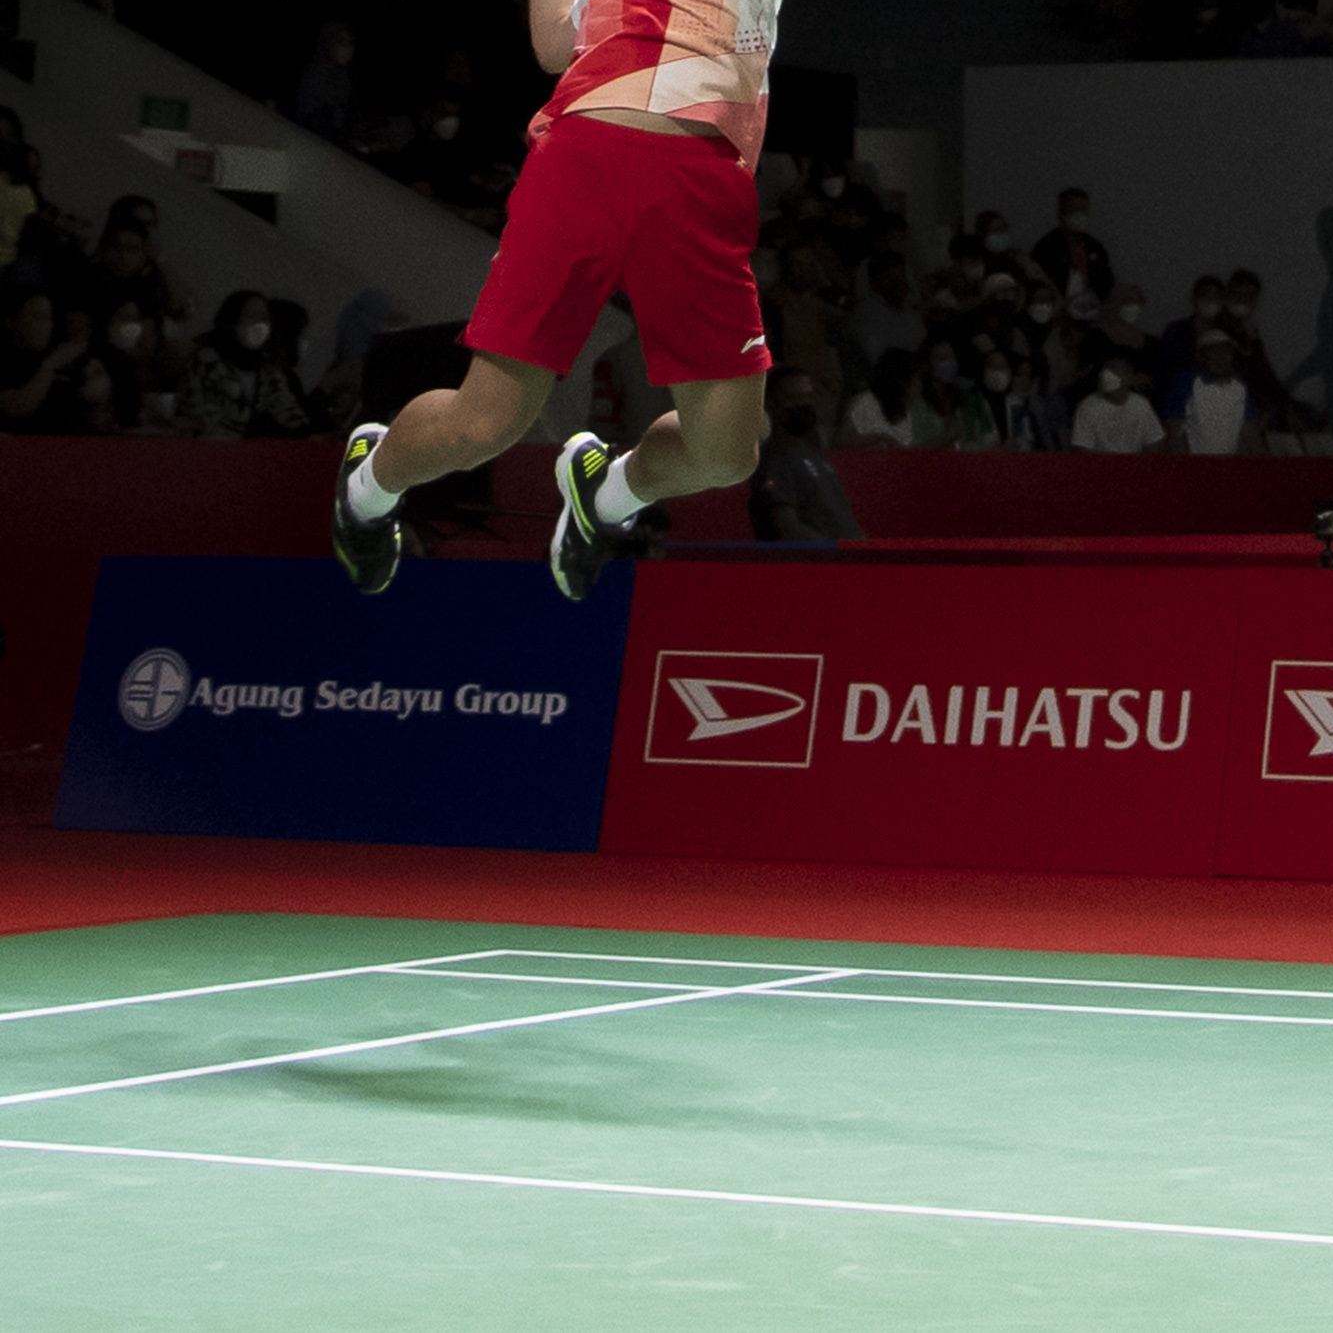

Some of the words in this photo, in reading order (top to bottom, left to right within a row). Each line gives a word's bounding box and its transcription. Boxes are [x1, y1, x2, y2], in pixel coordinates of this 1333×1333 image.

[190, 677, 304, 718] Agung
[315, 680, 443, 720] Sedayu
[454, 683, 568, 725] Group
[842, 682, 1192, 751] DAIHATSU
